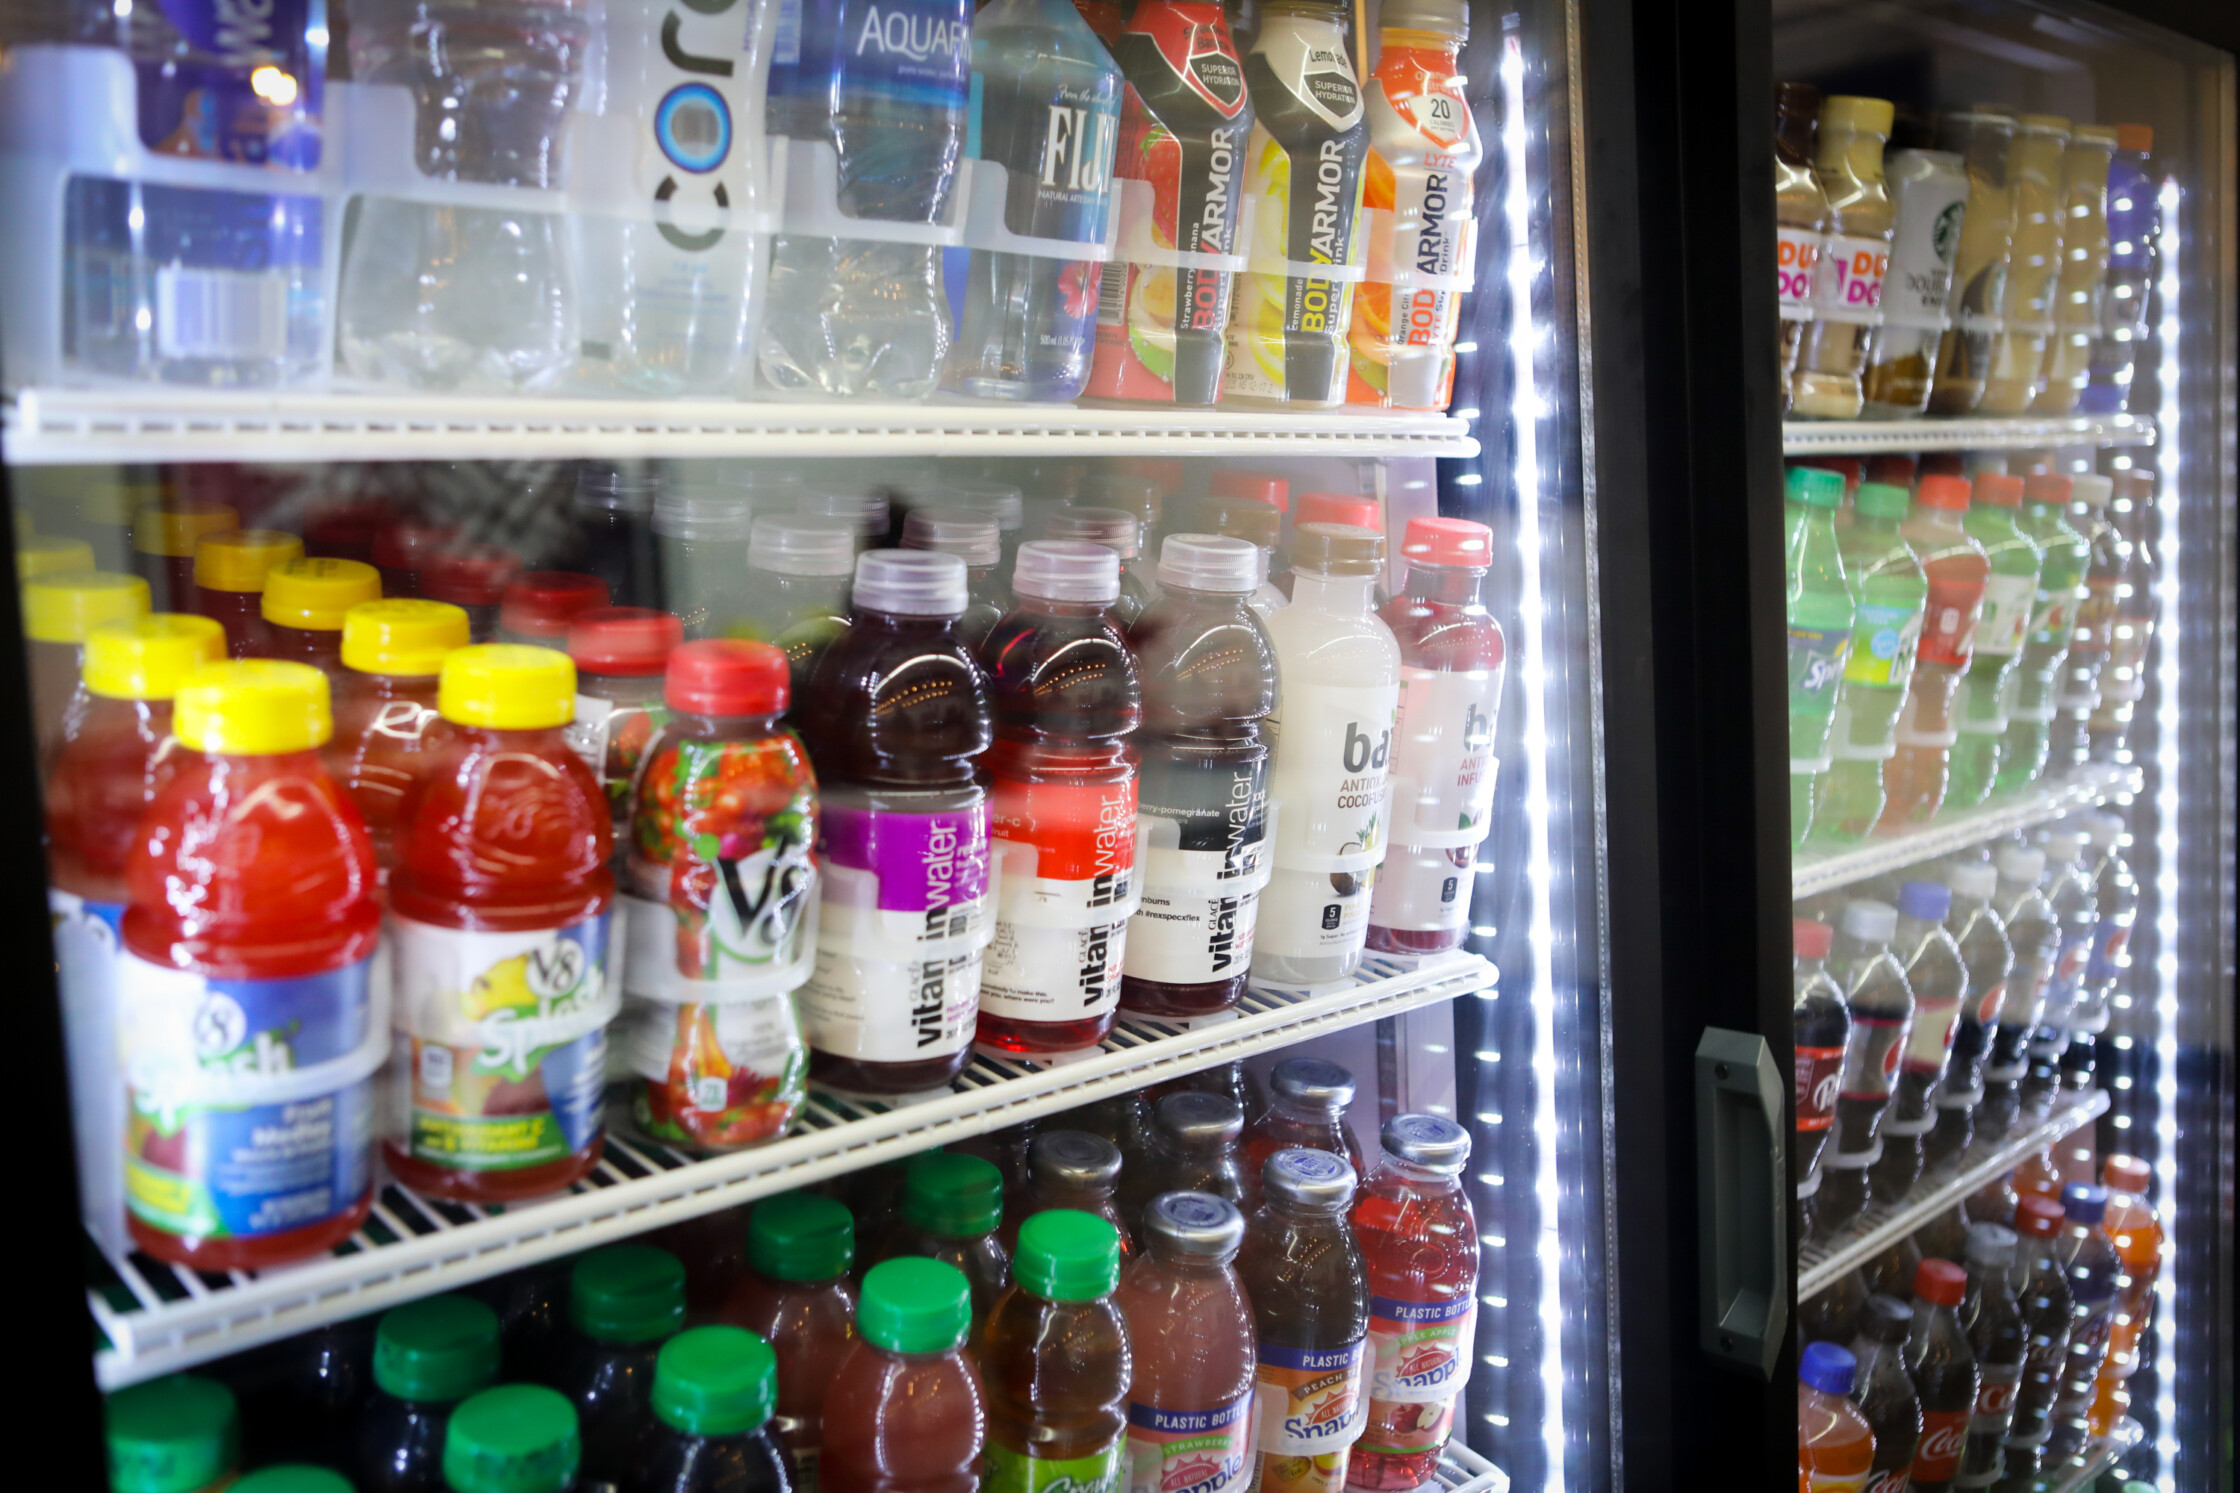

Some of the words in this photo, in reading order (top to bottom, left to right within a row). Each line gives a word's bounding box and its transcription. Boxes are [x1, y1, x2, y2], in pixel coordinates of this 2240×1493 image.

[1201, 63, 1236, 76] SUPERIOR
[1203, 74, 1240, 87] HYDRATION
[1314, 80, 1354, 95] SUPERIOR
[1315, 90, 1356, 105] HYDRATION
[1430, 98, 1451, 120] 20
[653, 0, 735, 252] cor
[1041, 104, 1116, 194] FIJI
[1423, 152, 1457, 169] LYTE
[1039, 190, 1068, 202] NATURAL
[1191, 128, 1234, 330] BODYARMOR
[1301, 139, 1345, 333] BODYARMOR
[1407, 173, 1448, 346] BODARMOR
[1291, 278, 1303, 331] Lemonade
[717, 833, 809, 945] V8
[1447, 879, 1454, 891] 5
[1329, 906, 1337, 918] 5
[533, 946, 575, 991] V8
[1395, 1306, 1441, 1319] PLASTIC
[1430, 1326, 1457, 1337] APPLE
[1302, 1353, 1349, 1368] PLASTIC
[1421, 1356, 1443, 1370] NATURAL
[1372, 1347, 1461, 1398] Snappl
[1304, 1373, 1344, 1394] PEACH
[1155, 1413, 1207, 1429] PLASTIC
[1211, 1404, 1245, 1426] BOTTL
[1321, 1408, 1331, 1418] ALL
[1170, 1475, 1182, 1487] ALL
[1184, 1468, 1208, 1482] NATURAL
